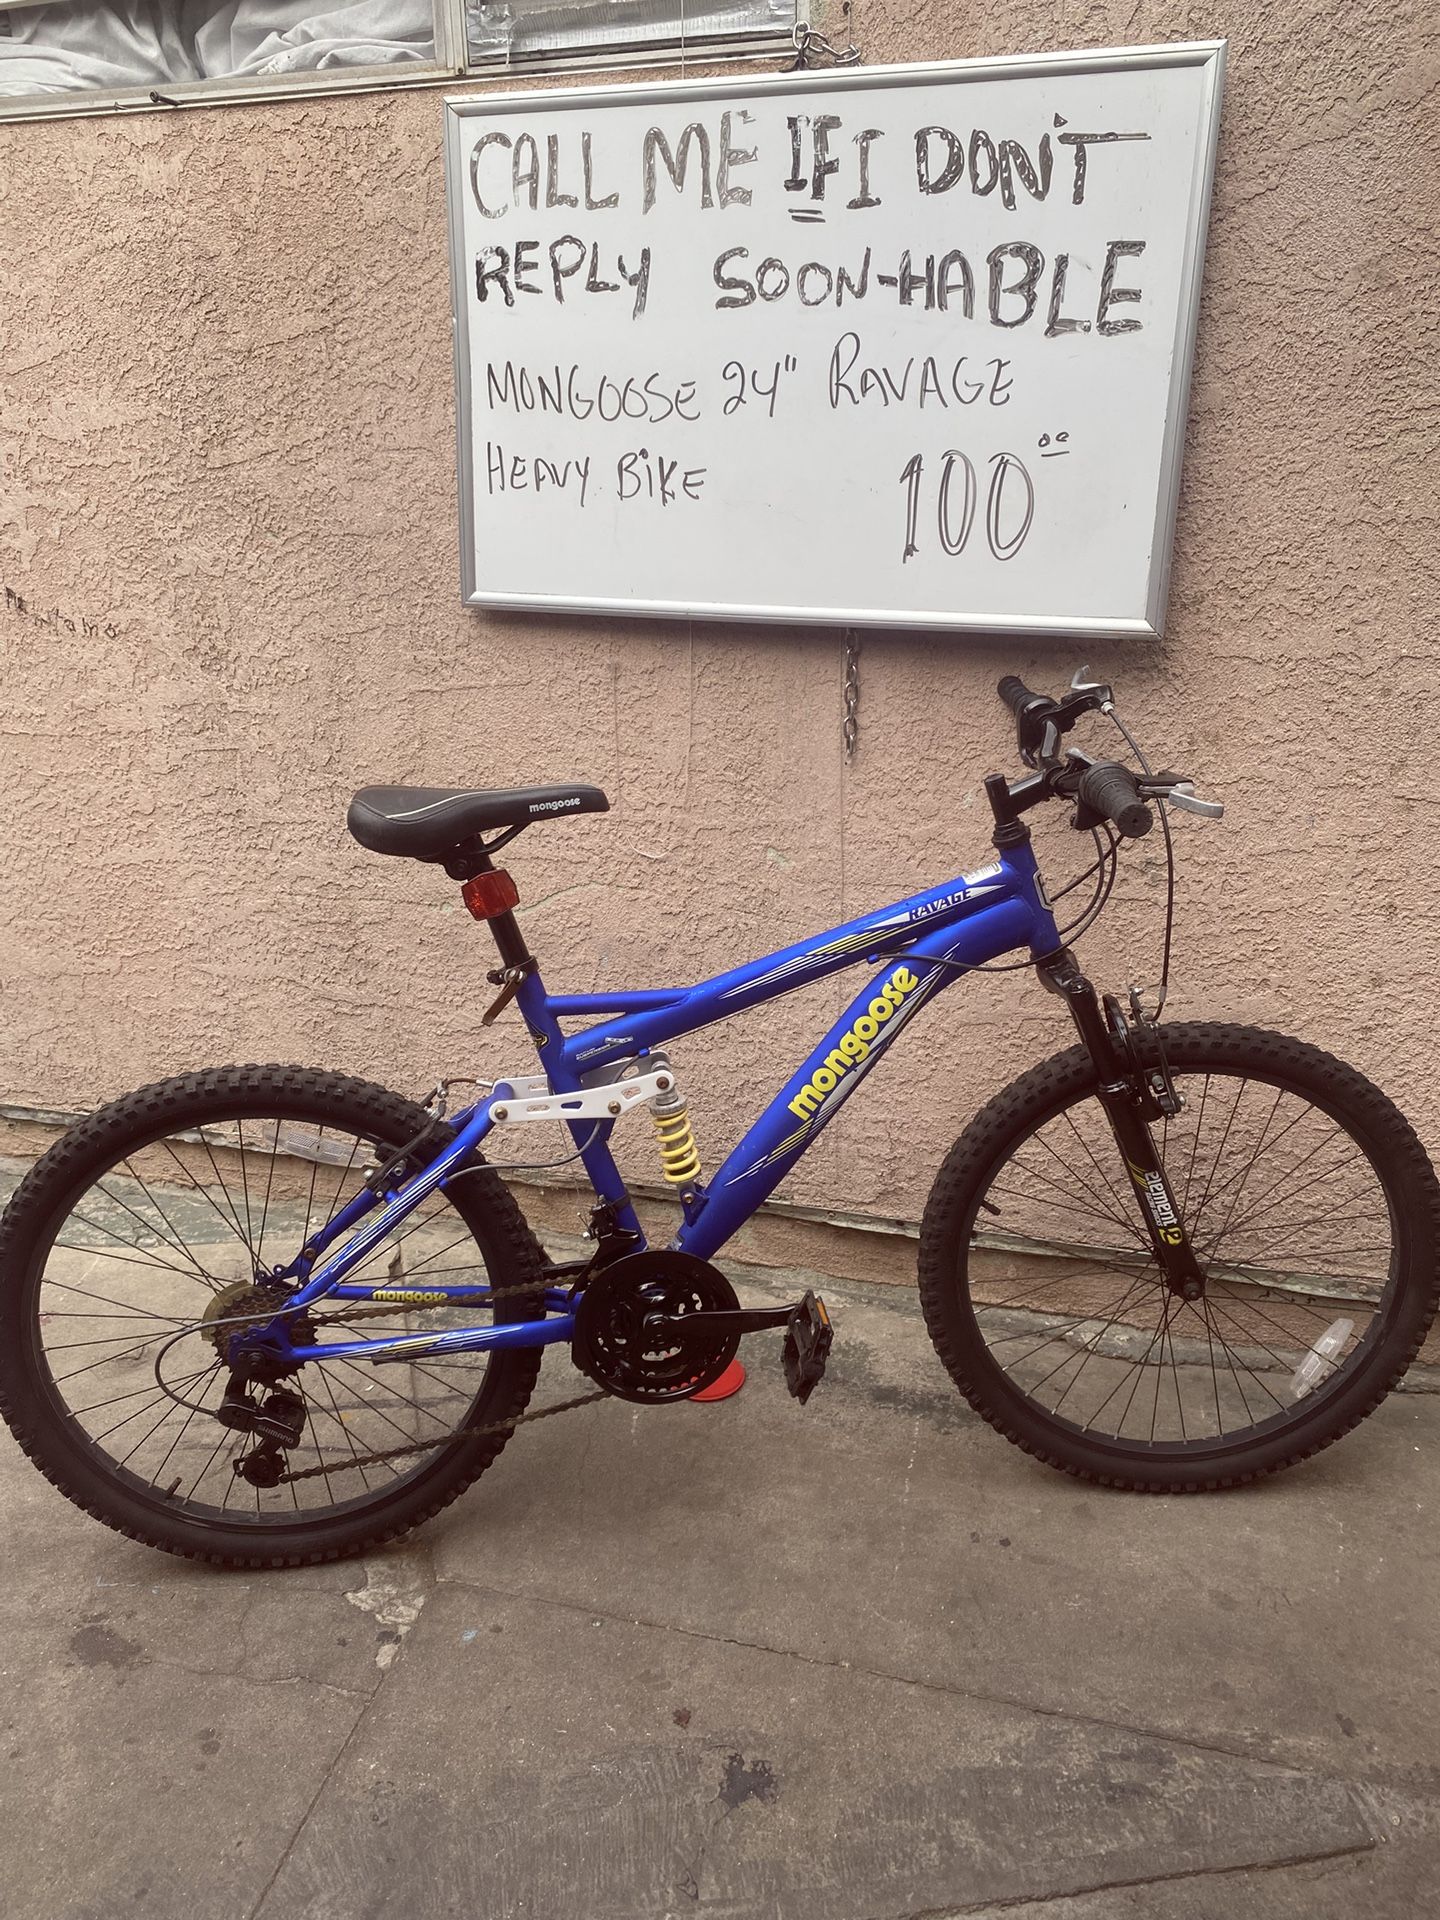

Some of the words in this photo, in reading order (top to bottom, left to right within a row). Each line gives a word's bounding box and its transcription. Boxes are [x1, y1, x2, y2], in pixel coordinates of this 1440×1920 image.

[470, 130, 620, 219] CALL
[642, 110, 759, 216] ME
[915, 112, 1152, 211] DON'T
[475, 234, 652, 320] REPLY
[487, 360, 702, 422] MONGOOSE
[722, 355, 799, 418] 24"
[828, 331, 1014, 409] RAVAGE
[487, 442, 592, 508] HEAVY
[529, 797, 581, 812] mongoose
[909, 888, 974, 920] RAVAGE
[787, 966, 919, 1121] mongoose
[1144, 1170, 1178, 1226] element
[372, 1289, 449, 1303] mongoose
